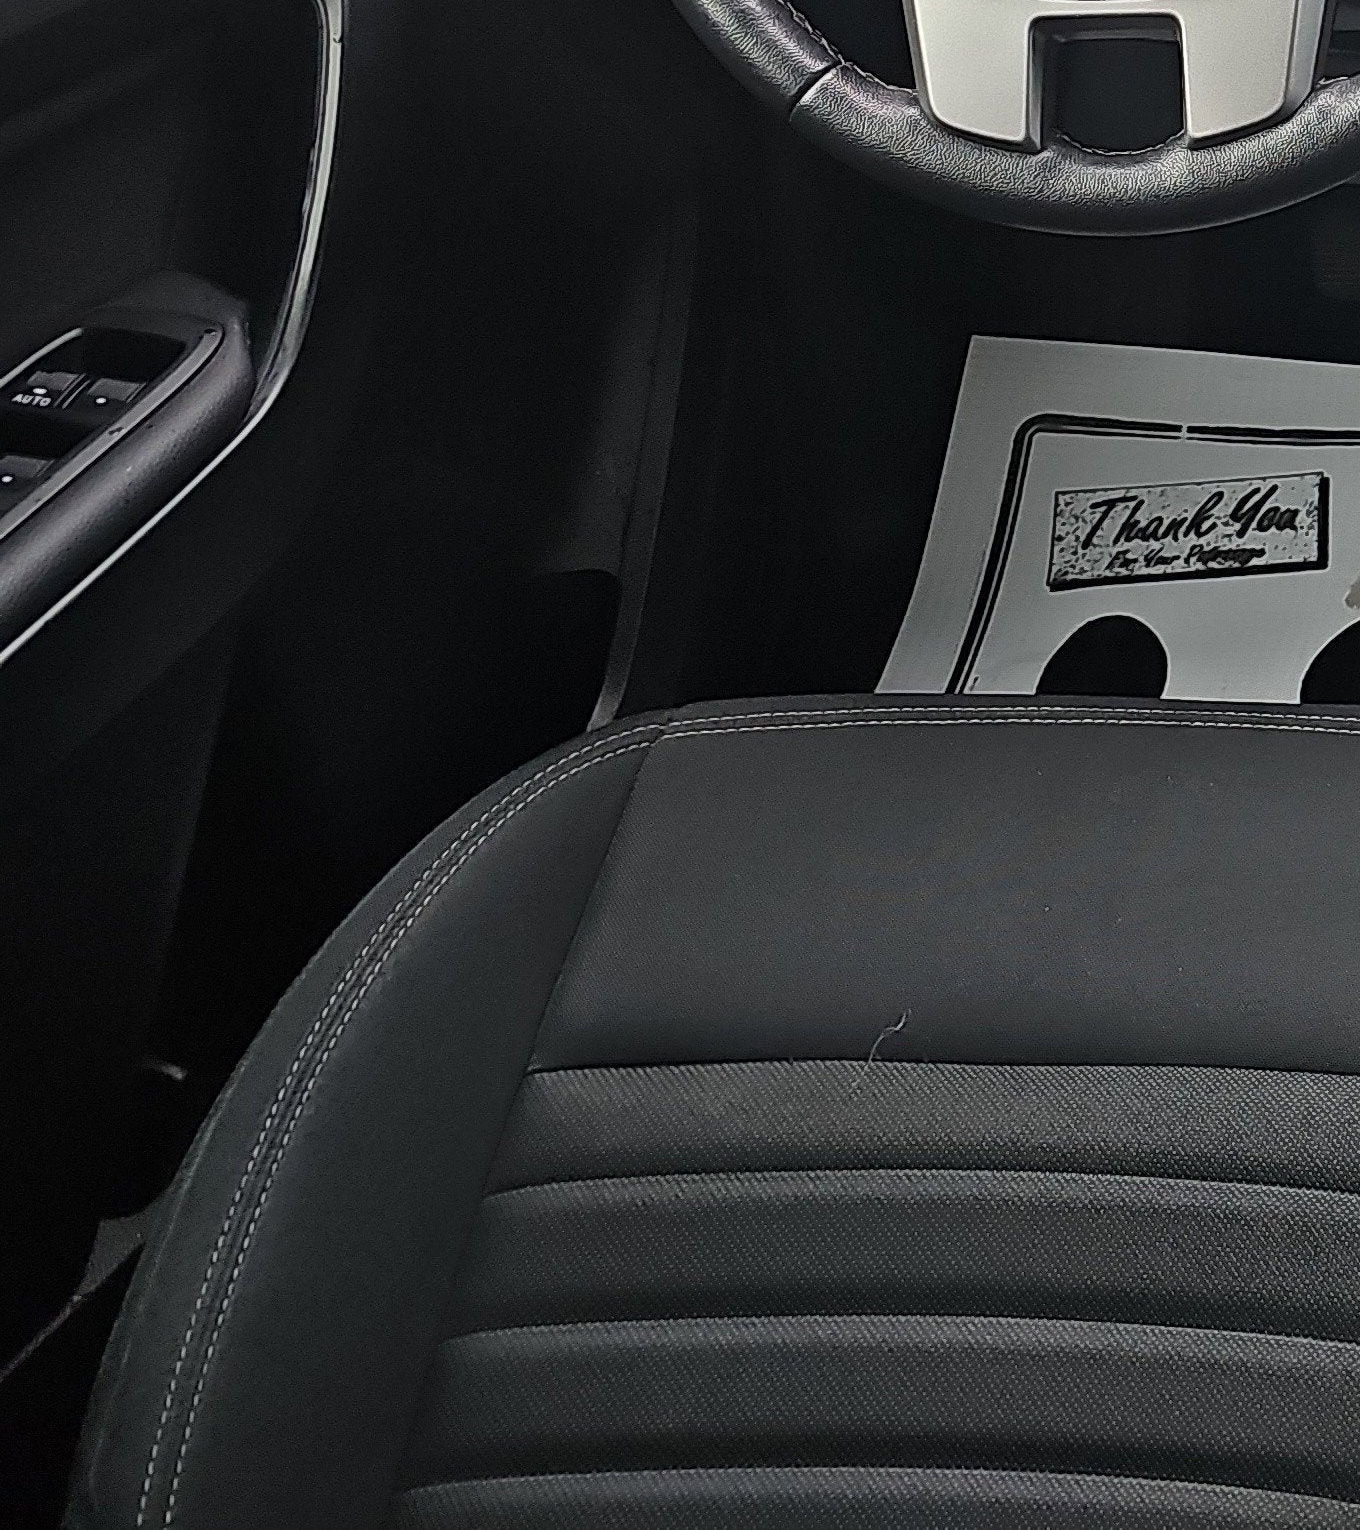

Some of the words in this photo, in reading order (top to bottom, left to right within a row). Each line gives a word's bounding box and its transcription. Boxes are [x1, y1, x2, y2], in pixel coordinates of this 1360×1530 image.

[11, 393, 52, 407] AUTO
[1081, 490, 1225, 550] Thank
[1229, 484, 1300, 539] You
